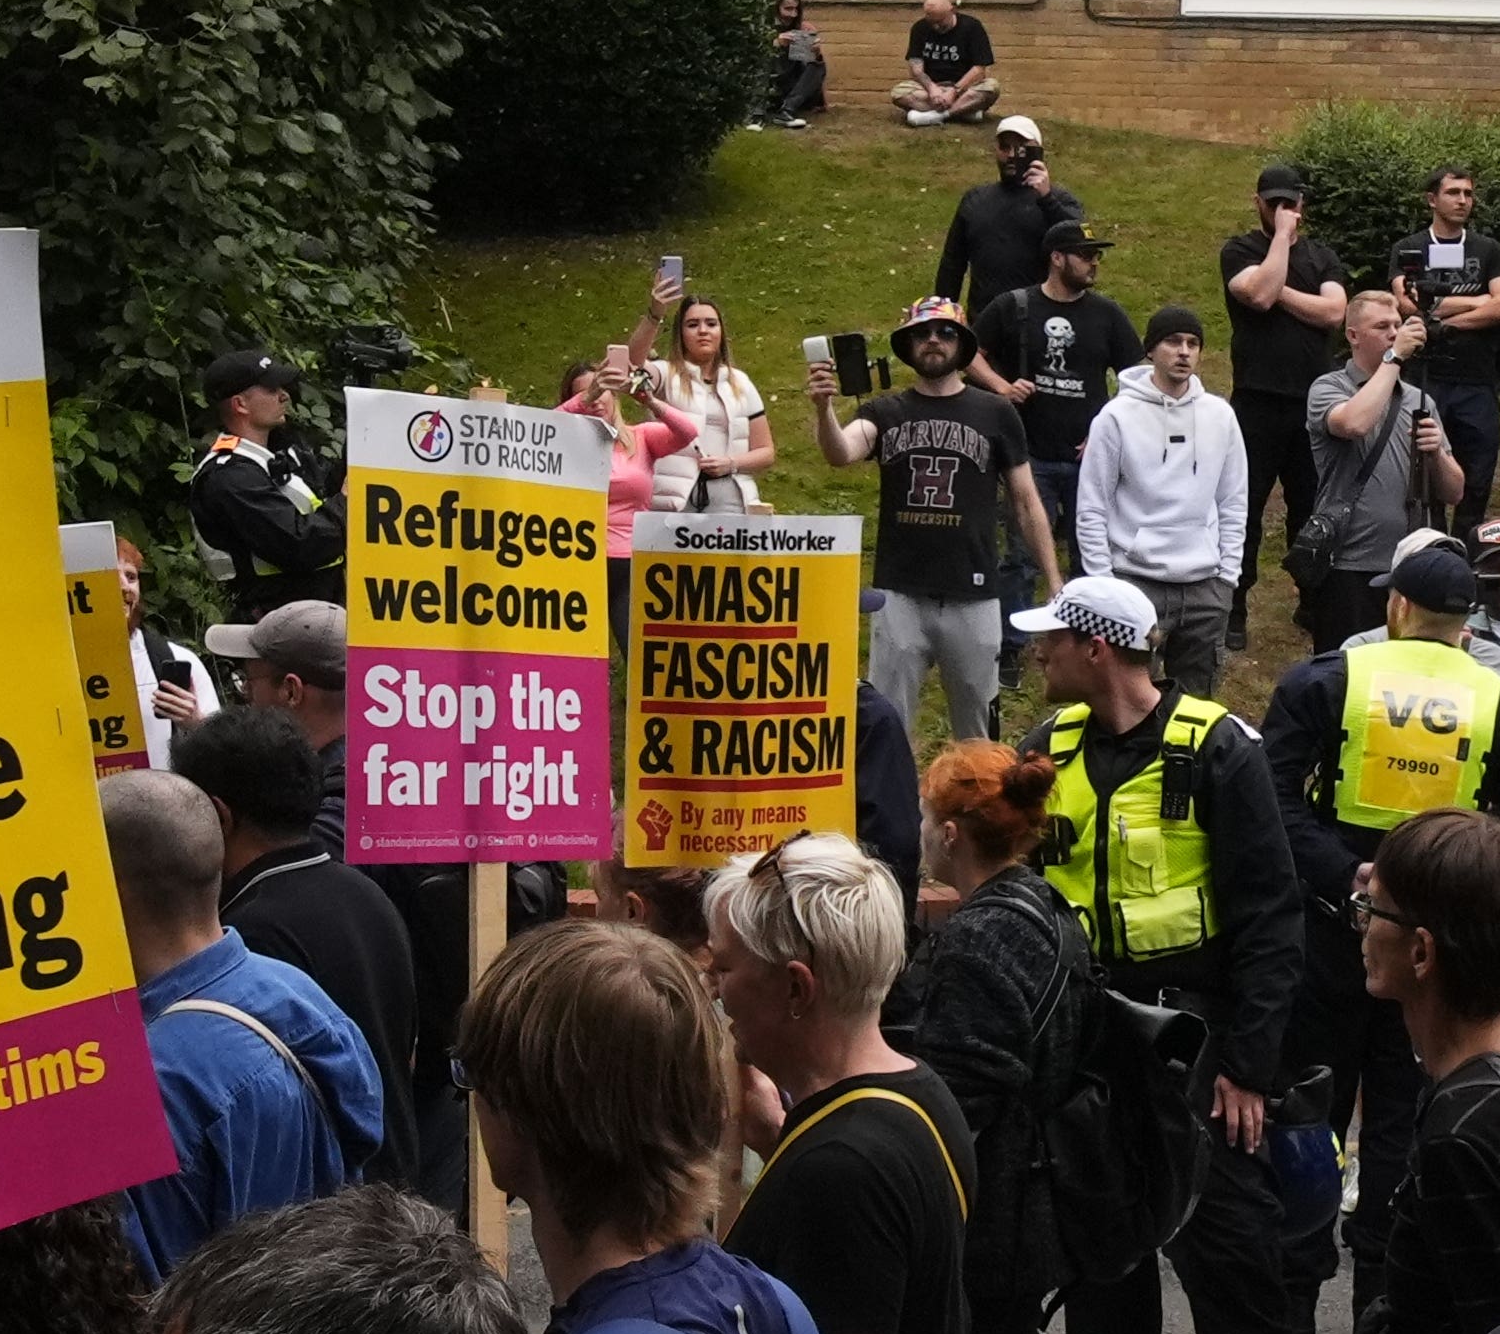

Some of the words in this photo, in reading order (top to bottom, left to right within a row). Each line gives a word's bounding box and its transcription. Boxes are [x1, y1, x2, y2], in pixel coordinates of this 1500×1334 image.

[460, 415, 525, 443] STAND
[531, 423, 555, 447] UP
[460, 442, 490, 465] TO
[498, 445, 562, 475] RACISM
[907, 455, 959, 508] H
[366, 484, 596, 568] Refugees
[674, 526, 768, 551] Socialist
[771, 529, 835, 551] Worker
[364, 566, 588, 632] welcome
[644, 563, 799, 623] SMASH
[642, 641, 829, 700] FASCISM
[364, 665, 495, 744] Stop
[510, 671, 581, 732] the
[1382, 691, 1458, 734] VG
[639, 717, 673, 774] &
[691, 716, 846, 775] RACISM
[1387, 757, 1439, 775] 79990
[363, 744, 447, 805] far
[464, 746, 578, 820] right
[680, 832, 775, 853] necessary
[681, 801, 704, 829] By
[712, 806, 744, 831] any
[752, 805, 806, 825] means
